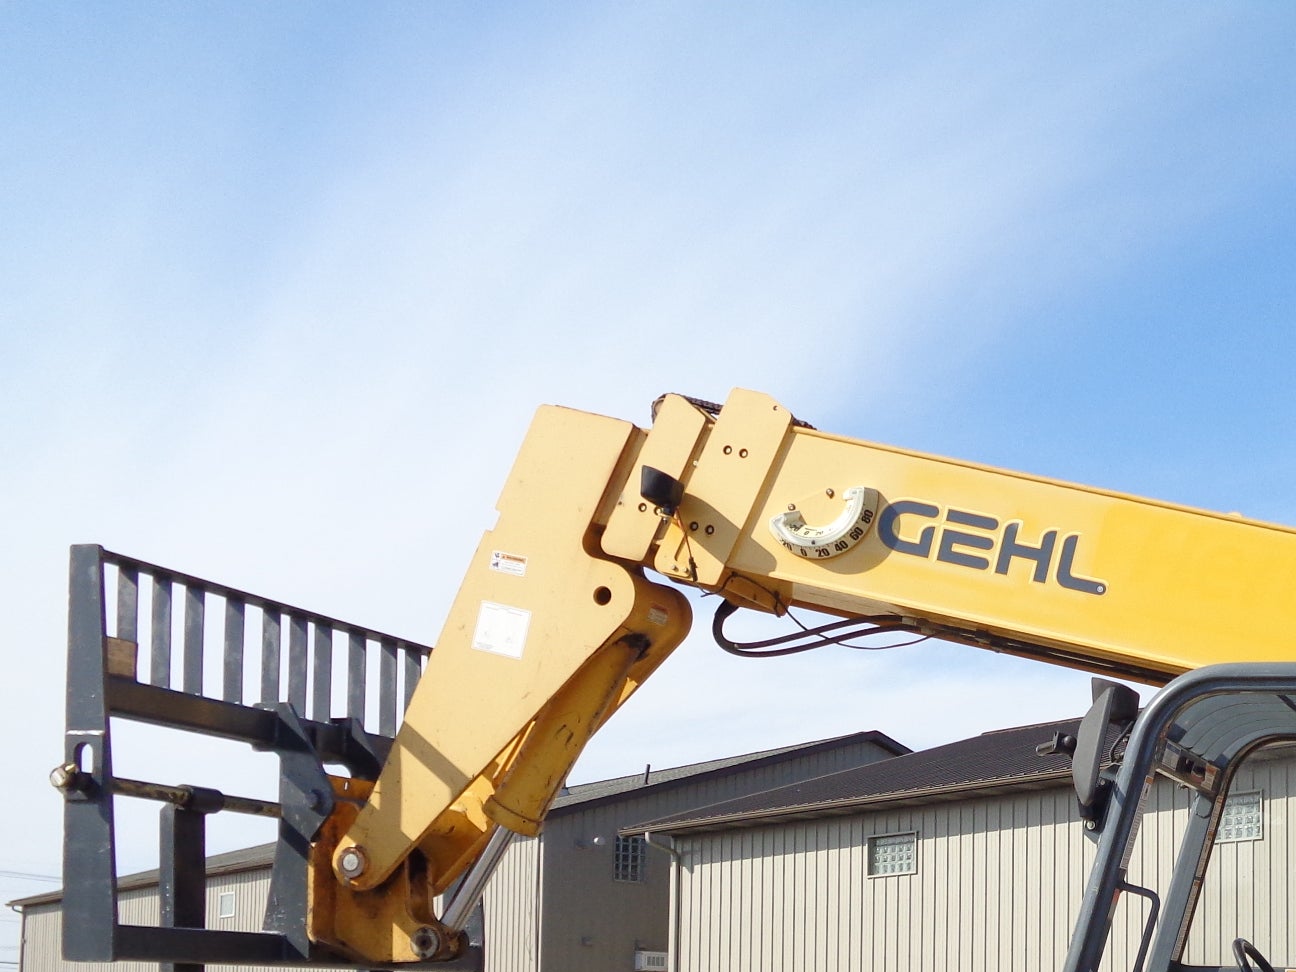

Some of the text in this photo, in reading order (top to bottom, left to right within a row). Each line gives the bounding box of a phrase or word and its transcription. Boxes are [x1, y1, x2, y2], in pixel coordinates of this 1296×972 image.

[815, 547, 830, 558] 20
[835, 540, 849, 552] 40
[850, 526, 864, 541] 60
[862, 509, 874, 525] 80
[878, 500, 1106, 595] GEHL
